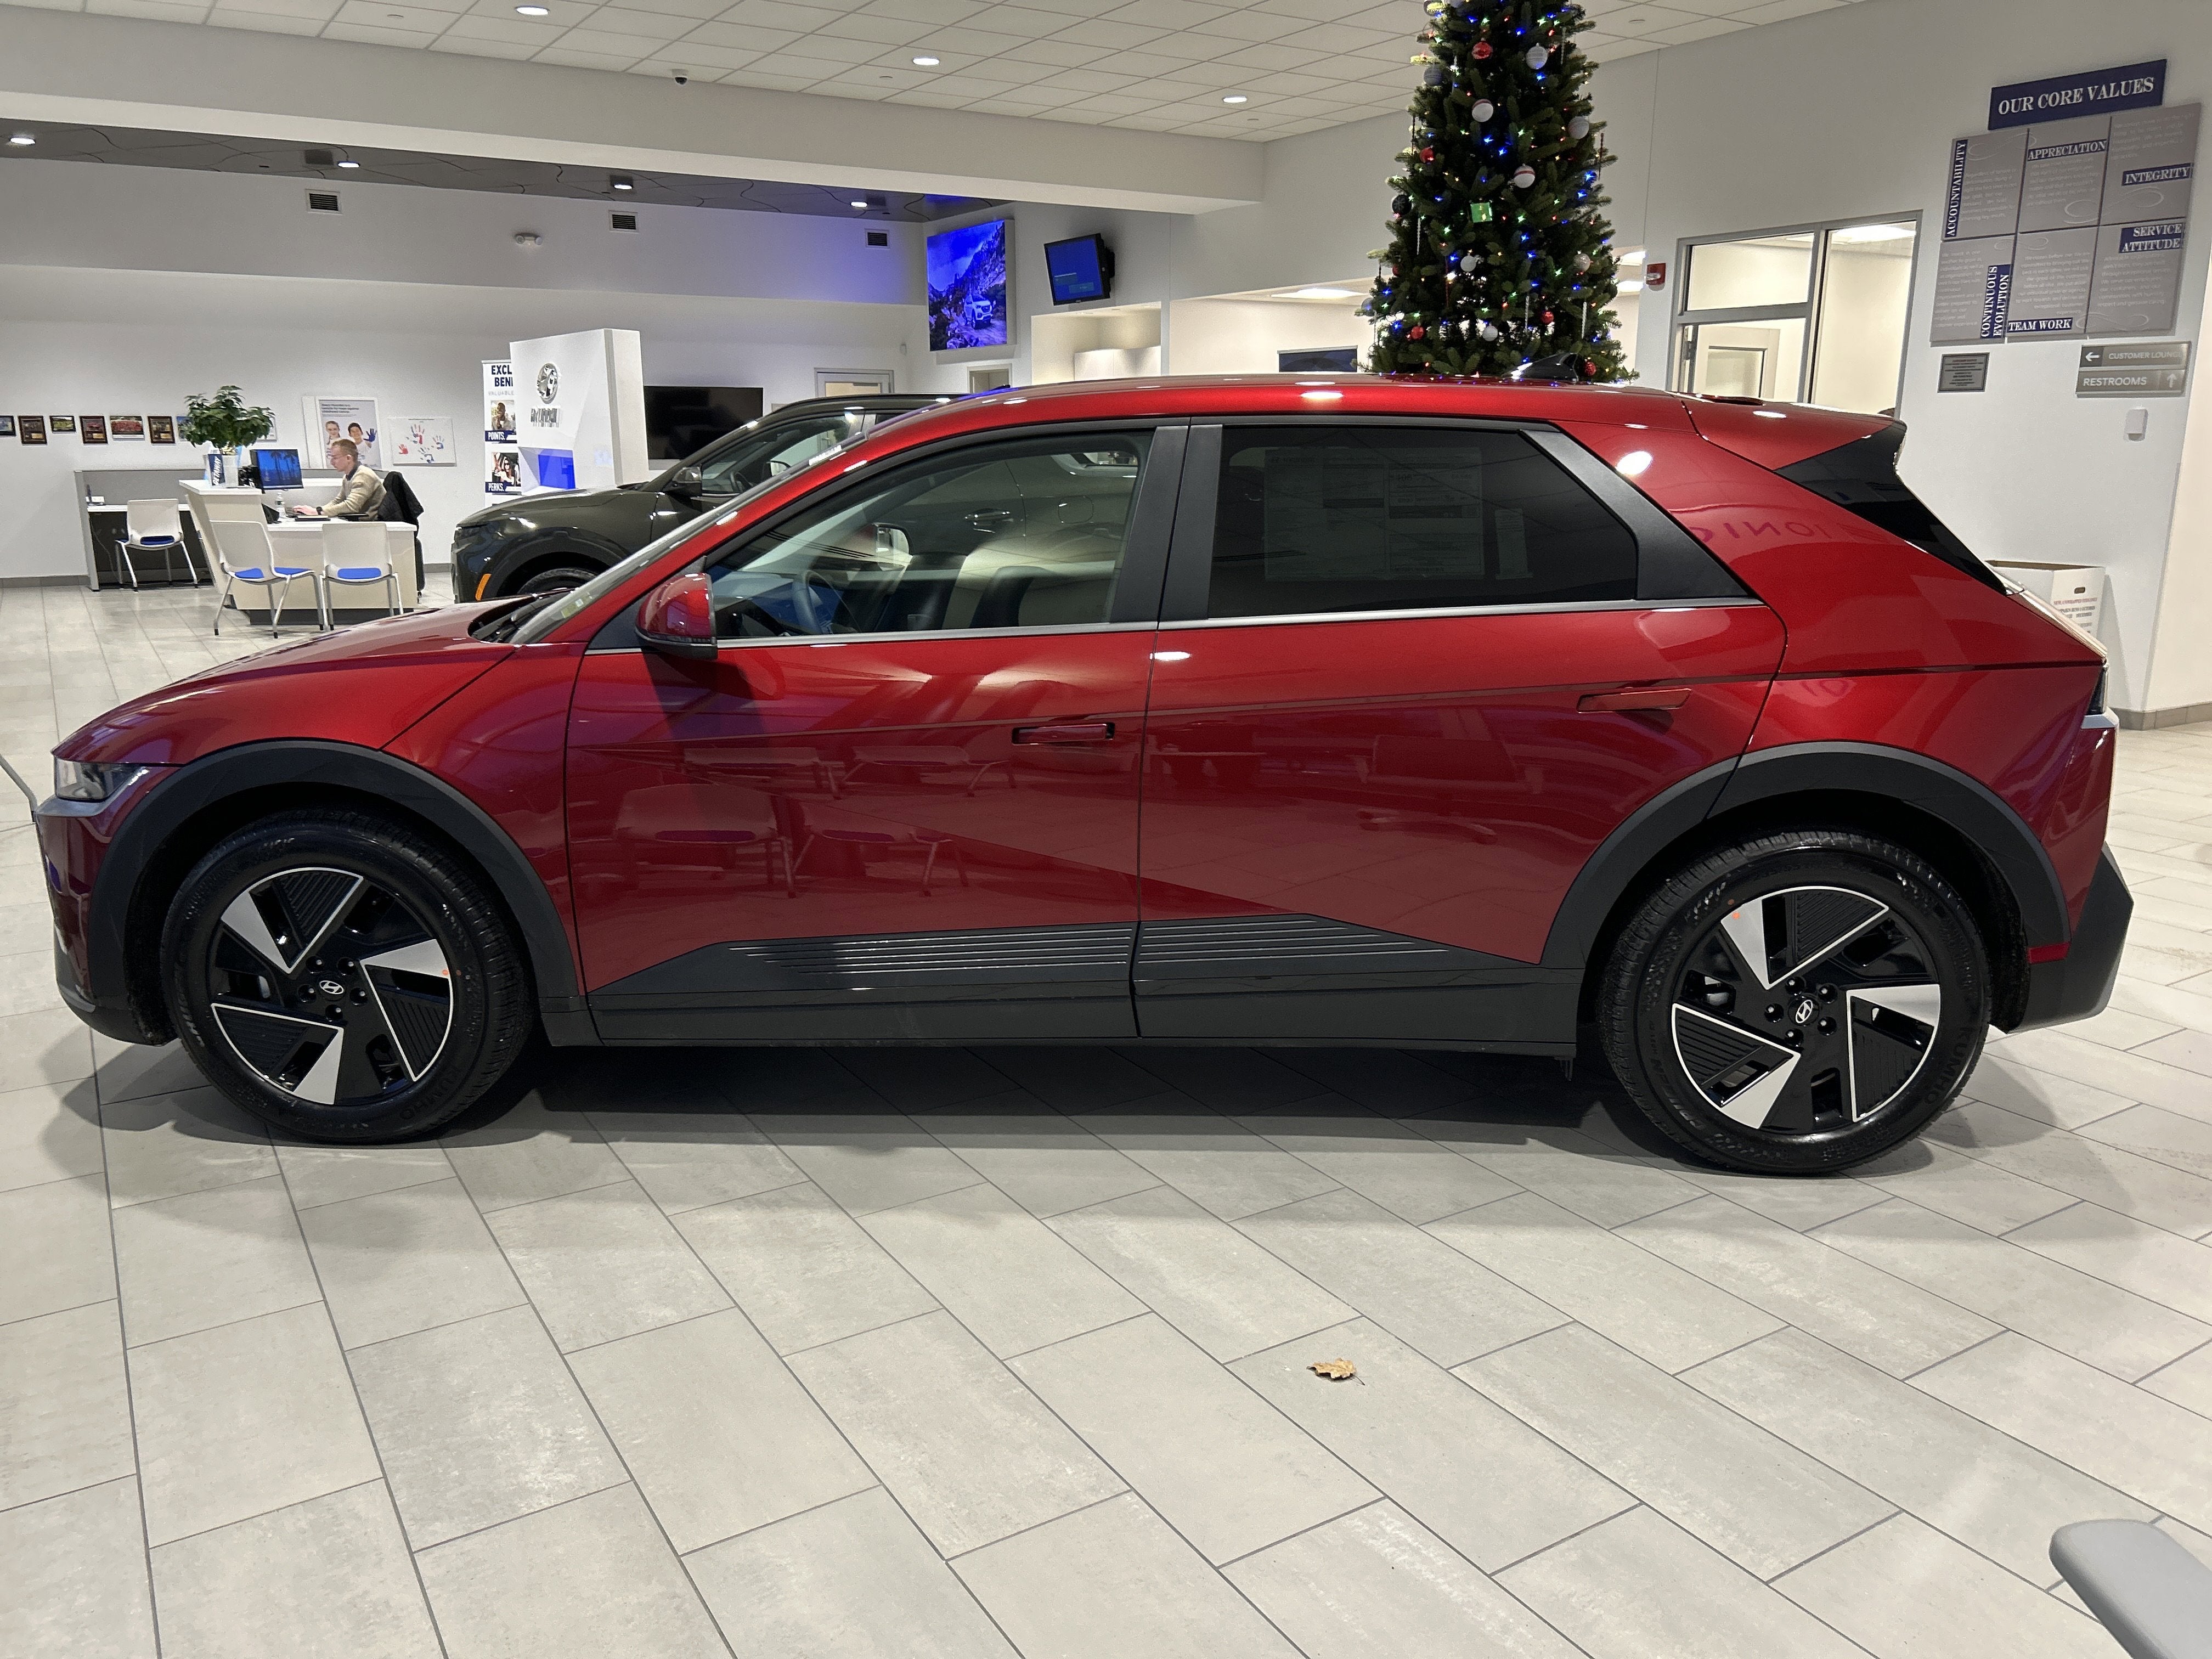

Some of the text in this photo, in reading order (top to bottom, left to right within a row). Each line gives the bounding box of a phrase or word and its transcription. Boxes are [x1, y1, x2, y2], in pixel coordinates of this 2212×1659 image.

[1998, 76, 2155, 115] OUR CORE VALUES
[2028, 140, 2107, 160] APPRECIATION
[2124, 167, 2190, 184] INTEGRITY
[1946, 141, 1967, 237] ACCOUNTABILITY
[2132, 223, 2182, 238] SERVICE
[2122, 238, 2181, 253] ATTITUDE
[1980, 266, 1998, 337] CONTINUOUS
[1993, 274, 2010, 336] EVOLUTION
[2008, 319, 2072, 331] TEAM WORK
[491, 364, 512, 375] EXCL
[2083, 376, 2147, 386] RESTROOMS
